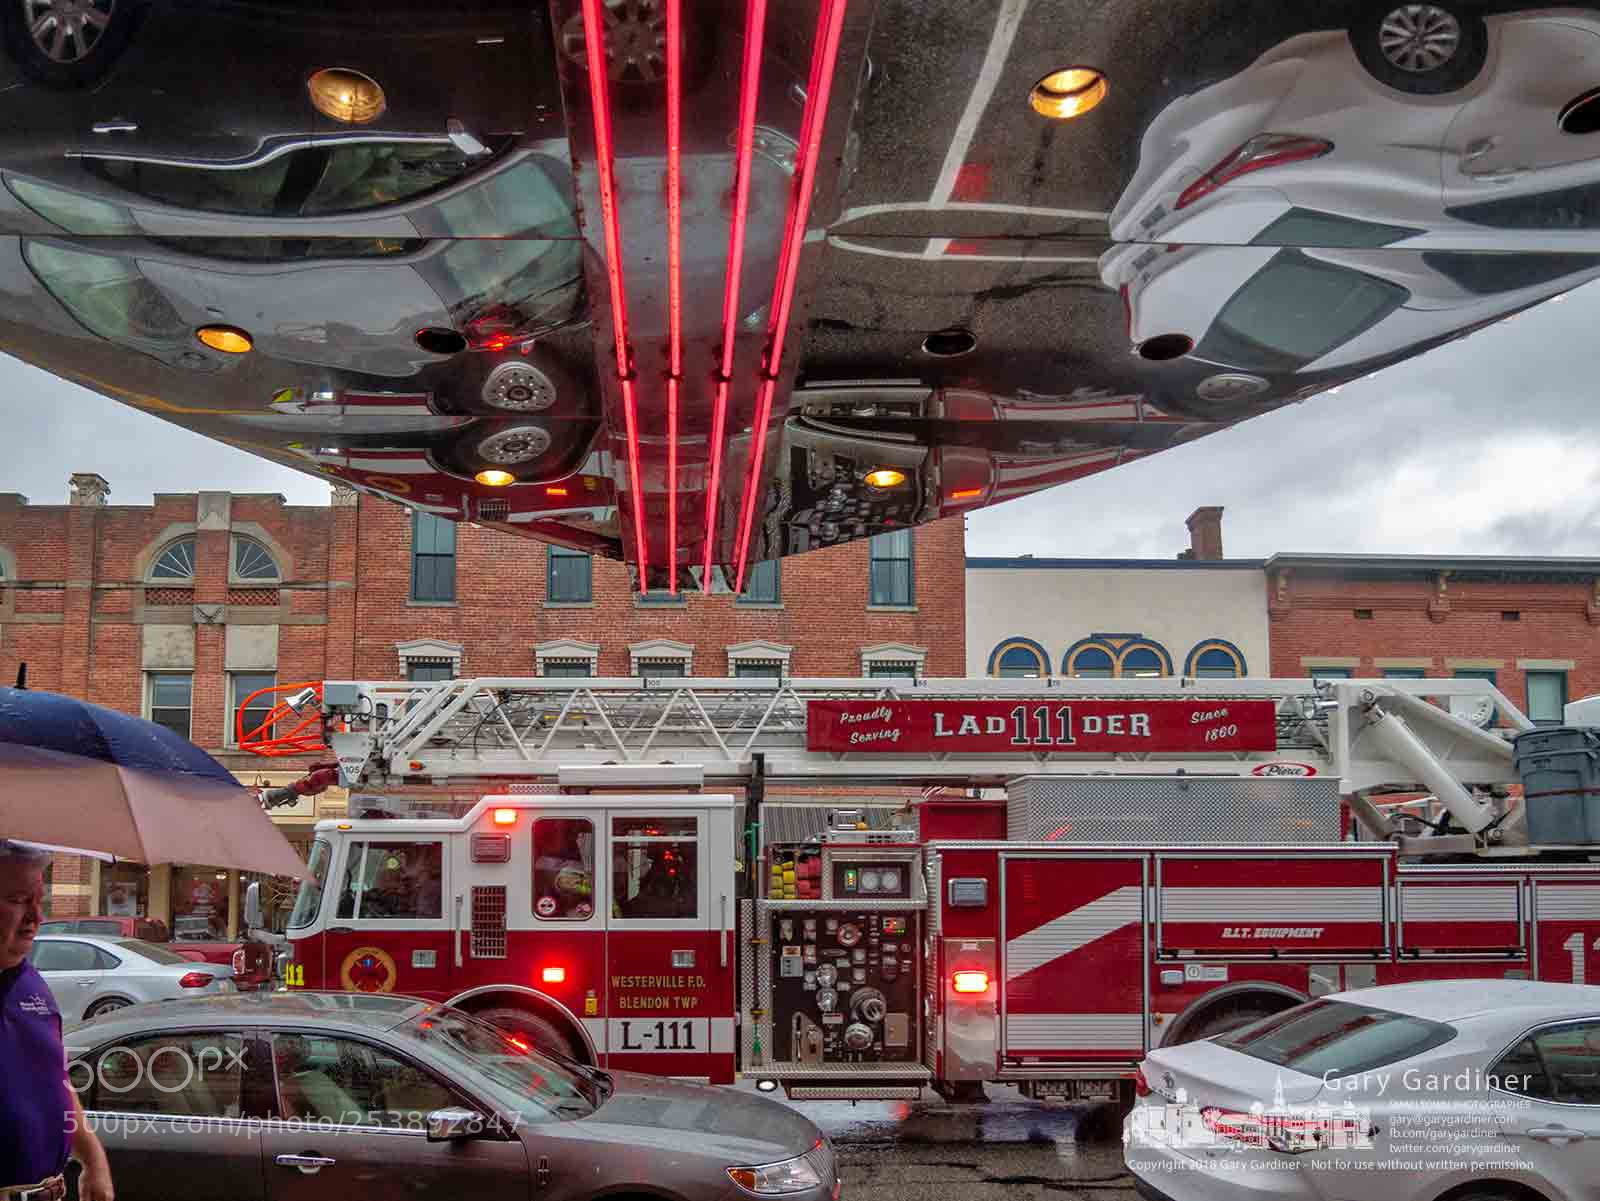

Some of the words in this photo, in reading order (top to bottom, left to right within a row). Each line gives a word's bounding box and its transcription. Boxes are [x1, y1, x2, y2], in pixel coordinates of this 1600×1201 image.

[840, 708, 893, 725] Proudly
[1191, 709, 1228, 725] Since
[1010, 705, 1077, 746] 111
[1205, 724, 1238, 741] 1860
[850, 728, 900, 744] Serving
[1267, 765, 1302, 776] Pierce
[1255, 928, 1324, 938] EQUIPMENT
[611, 976, 684, 988] WESTERVILLE
[688, 976, 706, 988] F.D.
[620, 997, 669, 1009] BLENDON
[674, 997, 698, 1009] TWP
[621, 1021, 696, 1050] L-111
